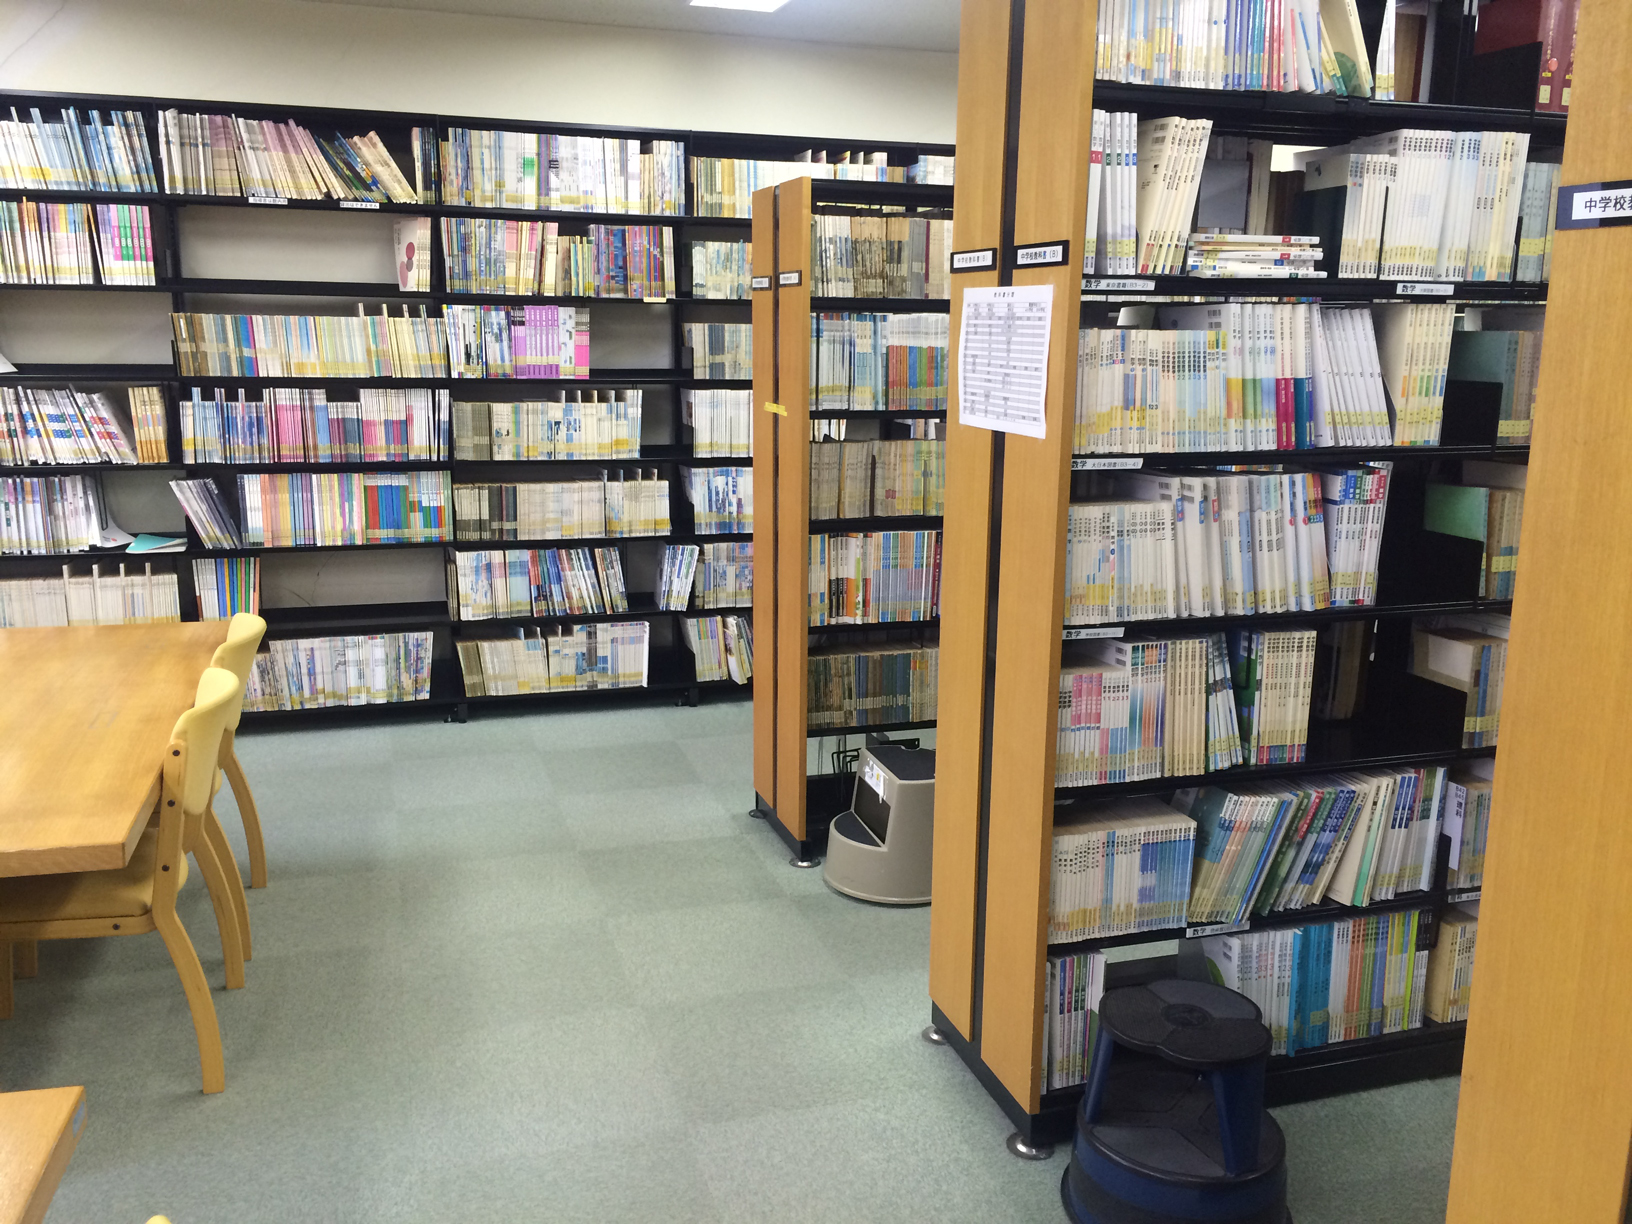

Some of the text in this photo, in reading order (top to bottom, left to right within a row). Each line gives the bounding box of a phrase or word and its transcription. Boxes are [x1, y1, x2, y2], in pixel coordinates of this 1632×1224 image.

[1584, 194, 1632, 213] 中学校
[1084, 280, 1101, 288] 数学
[1402, 284, 1416, 293] 数学
[1072, 460, 1087, 468] 数学
[1066, 630, 1081, 638] 数学
